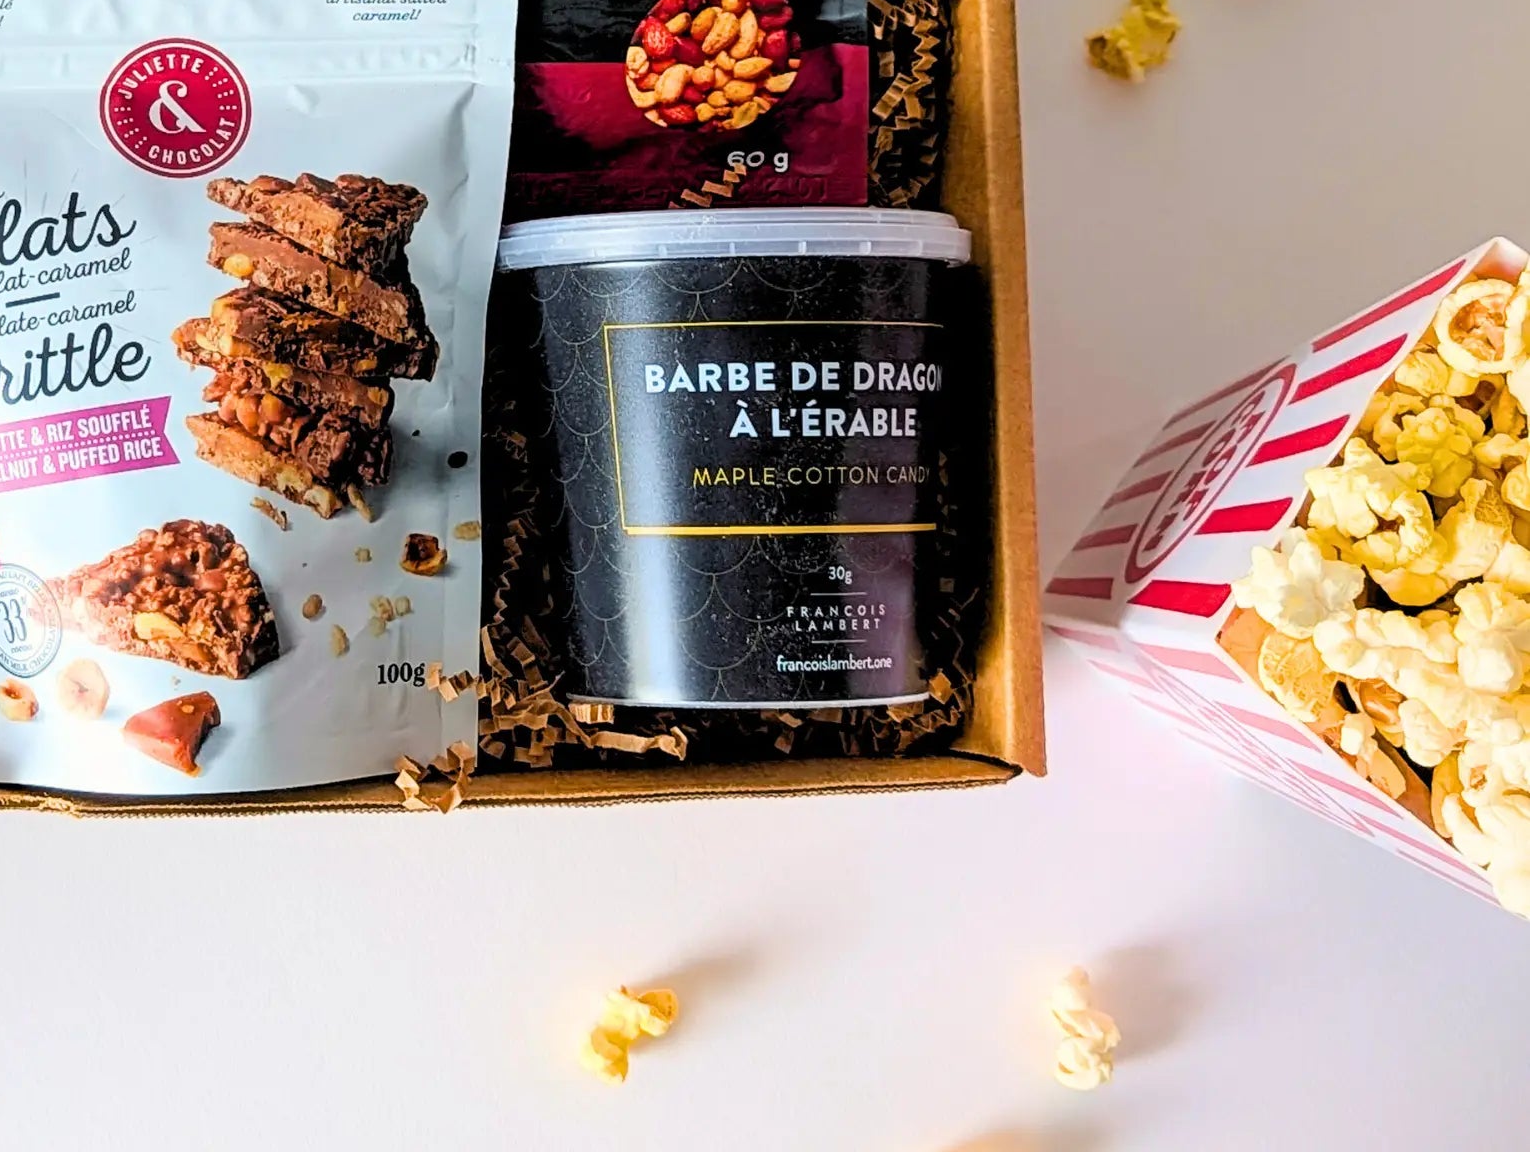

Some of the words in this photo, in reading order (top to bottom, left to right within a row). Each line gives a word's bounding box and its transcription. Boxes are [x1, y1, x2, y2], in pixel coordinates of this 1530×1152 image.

[352, 9, 422, 21] caramel!
[117, 54, 204, 100] JULIETTE
[149, 80, 207, 134] &
[148, 117, 236, 165] CHOCOLAT
[727, 150, 765, 167] 60
[773, 152, 789, 173] g
[644, 361, 776, 393] BARBE
[791, 361, 840, 391] DE
[30, 426, 45, 446] &
[46, 421, 75, 443] RIZ
[77, 404, 152, 438] SOUFFLÉ
[729, 399, 758, 438] À
[771, 399, 917, 437] L'ÉRABLE
[42, 455, 57, 475] &
[58, 443, 120, 472] PUFFED
[124, 436, 163, 461] RICE
[693, 467, 776, 486] MAPLE
[787, 466, 879, 485] COTTON
[886, 466, 930, 484] CANDY
[828, 565, 853, 585] 30g
[795, 618, 881, 632] LAMBERT
[377, 662, 425, 687] 100g
[776, 654, 892, 672] francoislambert.one
